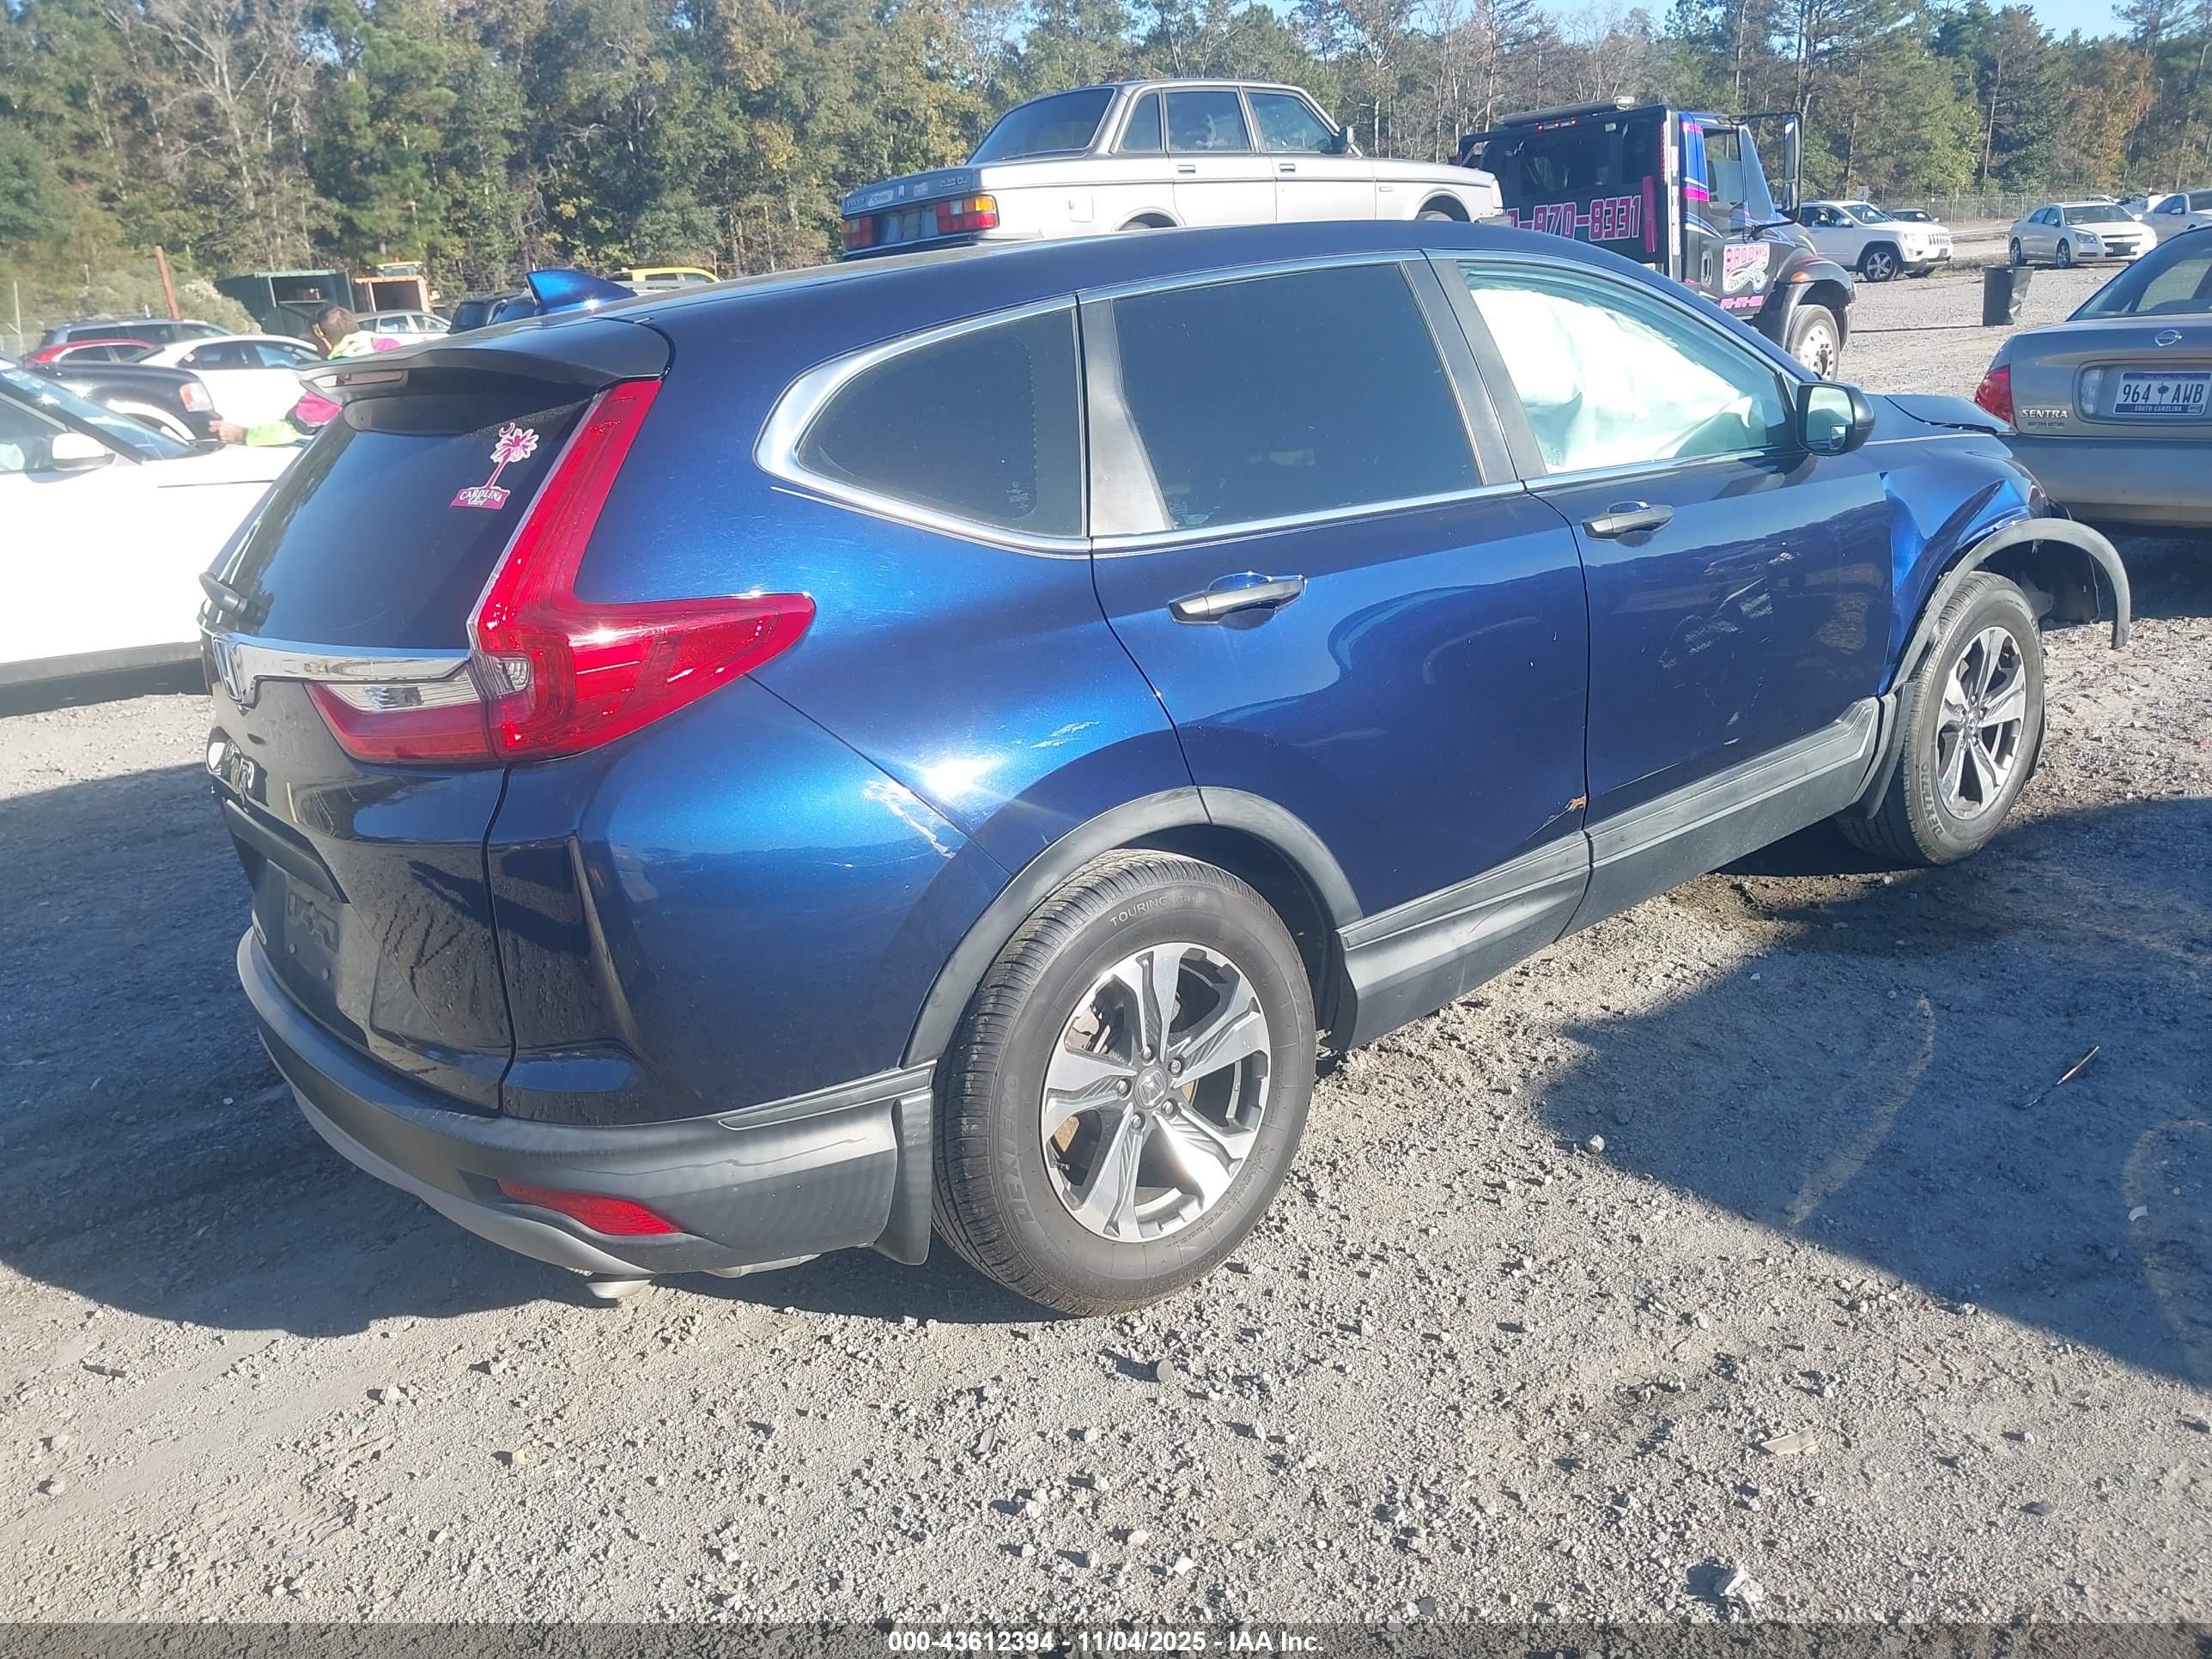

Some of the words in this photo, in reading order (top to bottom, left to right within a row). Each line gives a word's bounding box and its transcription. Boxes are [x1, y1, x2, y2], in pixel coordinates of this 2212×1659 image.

[2123, 383, 2152, 404] 964
[2171, 383, 2205, 404] AWB
[2021, 409, 2069, 419] SENTRA
[459, 489, 503, 502] CAROLINA
[1109, 895, 1168, 927] TOURING
